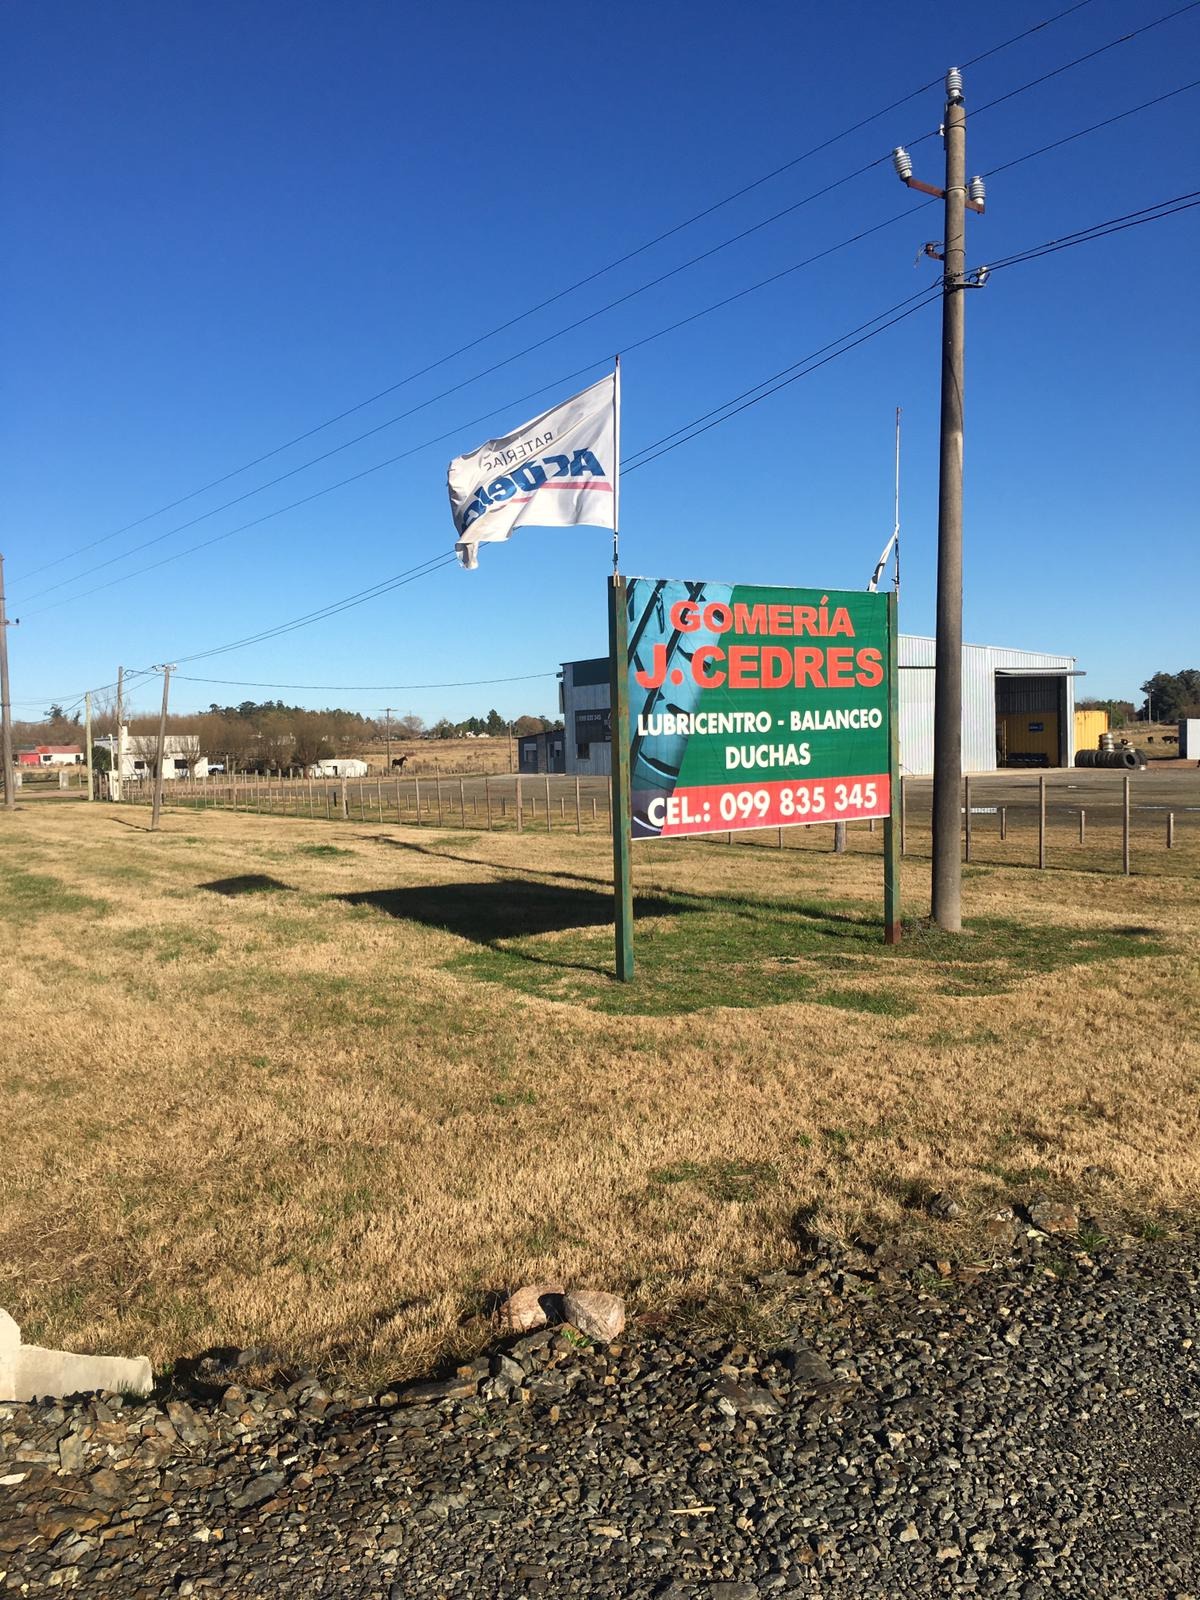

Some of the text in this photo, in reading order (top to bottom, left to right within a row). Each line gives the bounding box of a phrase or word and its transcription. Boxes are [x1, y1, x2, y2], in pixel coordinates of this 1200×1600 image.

[669, 595, 856, 638] GOMERÍA
[634, 644, 885, 690] J. CEDRES
[637, 711, 773, 737] LUBRICENTRO
[790, 708, 883, 732] BALANCEO
[725, 742, 811, 770] DUCHAS
[647, 782, 878, 828] CEL.: 099 835 345
